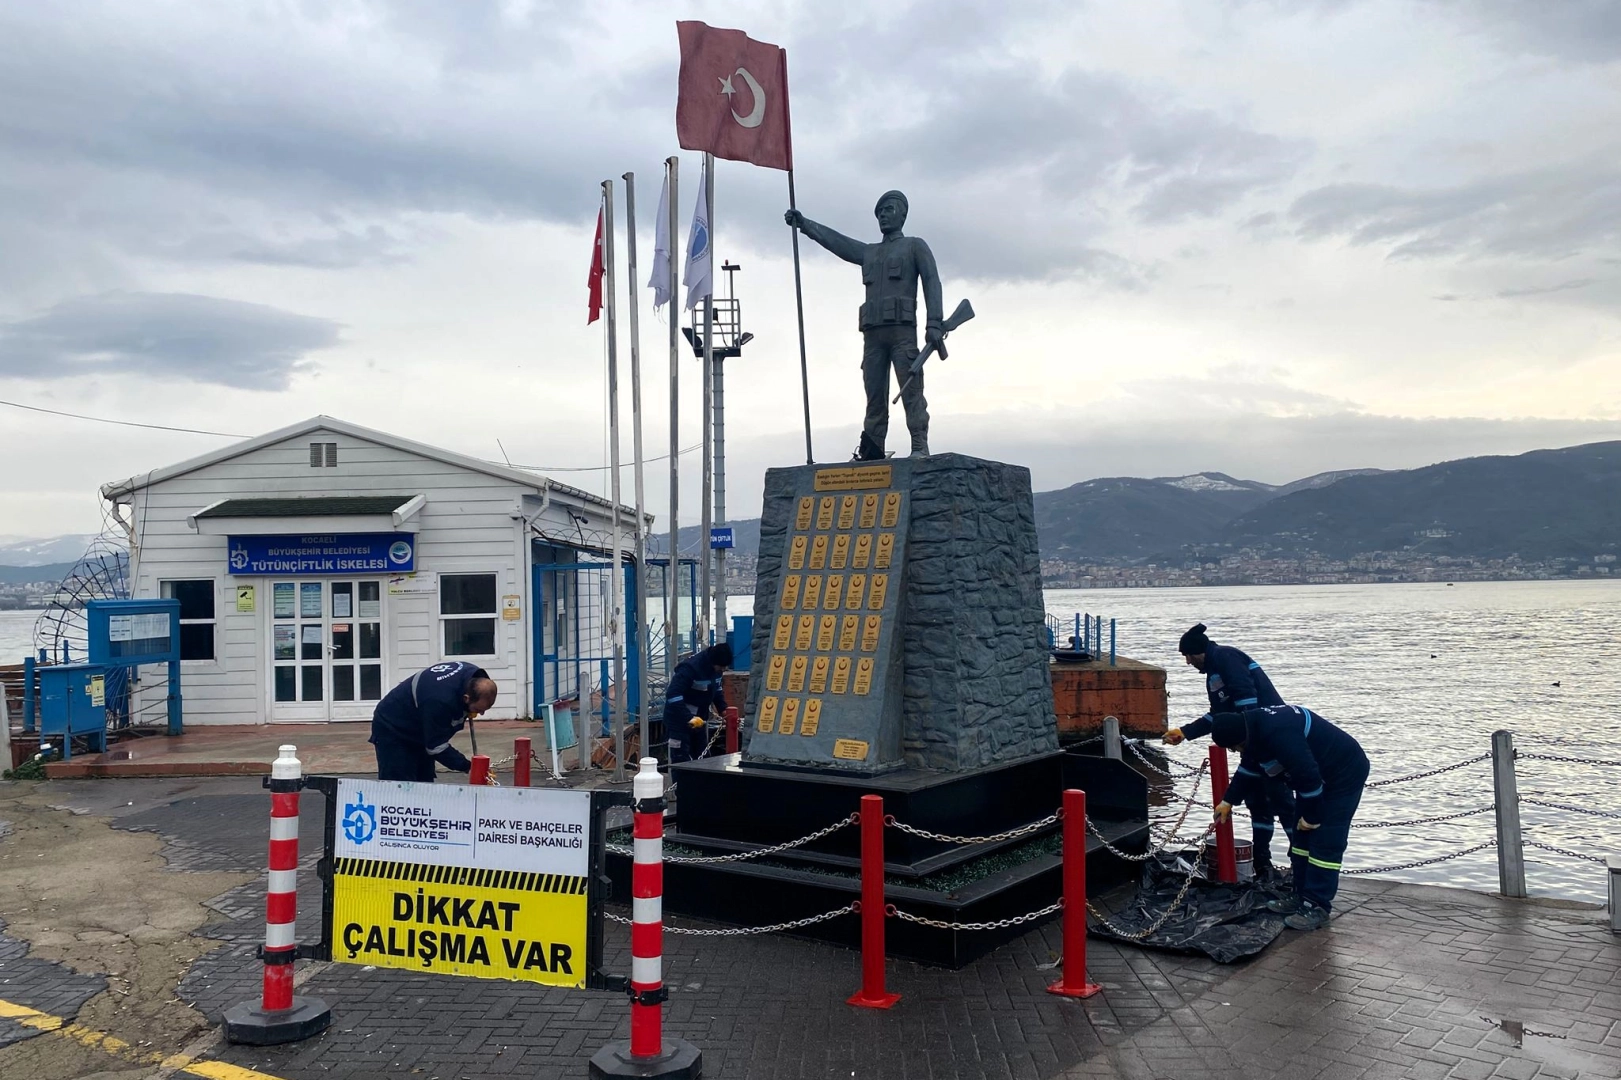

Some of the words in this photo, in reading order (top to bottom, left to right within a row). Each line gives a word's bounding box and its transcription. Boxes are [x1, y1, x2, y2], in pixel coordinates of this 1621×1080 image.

[301, 536, 337, 544] KOCAELİ
[268, 547, 321, 557] BÜYÜKŞEHİR
[322, 546, 371, 555] BELEDİYESİ
[251, 558, 334, 573] TÜTÜNÇİFTLİK
[336, 557, 388, 570] İSKELESİ
[381, 805, 432, 817] KOCAELİ
[380, 815, 472, 831] BÜYÜKŞEHİR
[478, 818, 506, 829] PARK
[509, 820, 523, 830] VE
[525, 821, 583, 834] BAHÇELER
[380, 827, 449, 840] BELEDİYESİ
[478, 831, 518, 844] DAİRESİ
[520, 835, 582, 849] BAŞKANLIĞI
[413, 843, 440, 851] OLUYOR
[392, 887, 520, 932] DİKKAT
[342, 922, 491, 967] ÇALIŞMA
[502, 938, 573, 975] VAR
